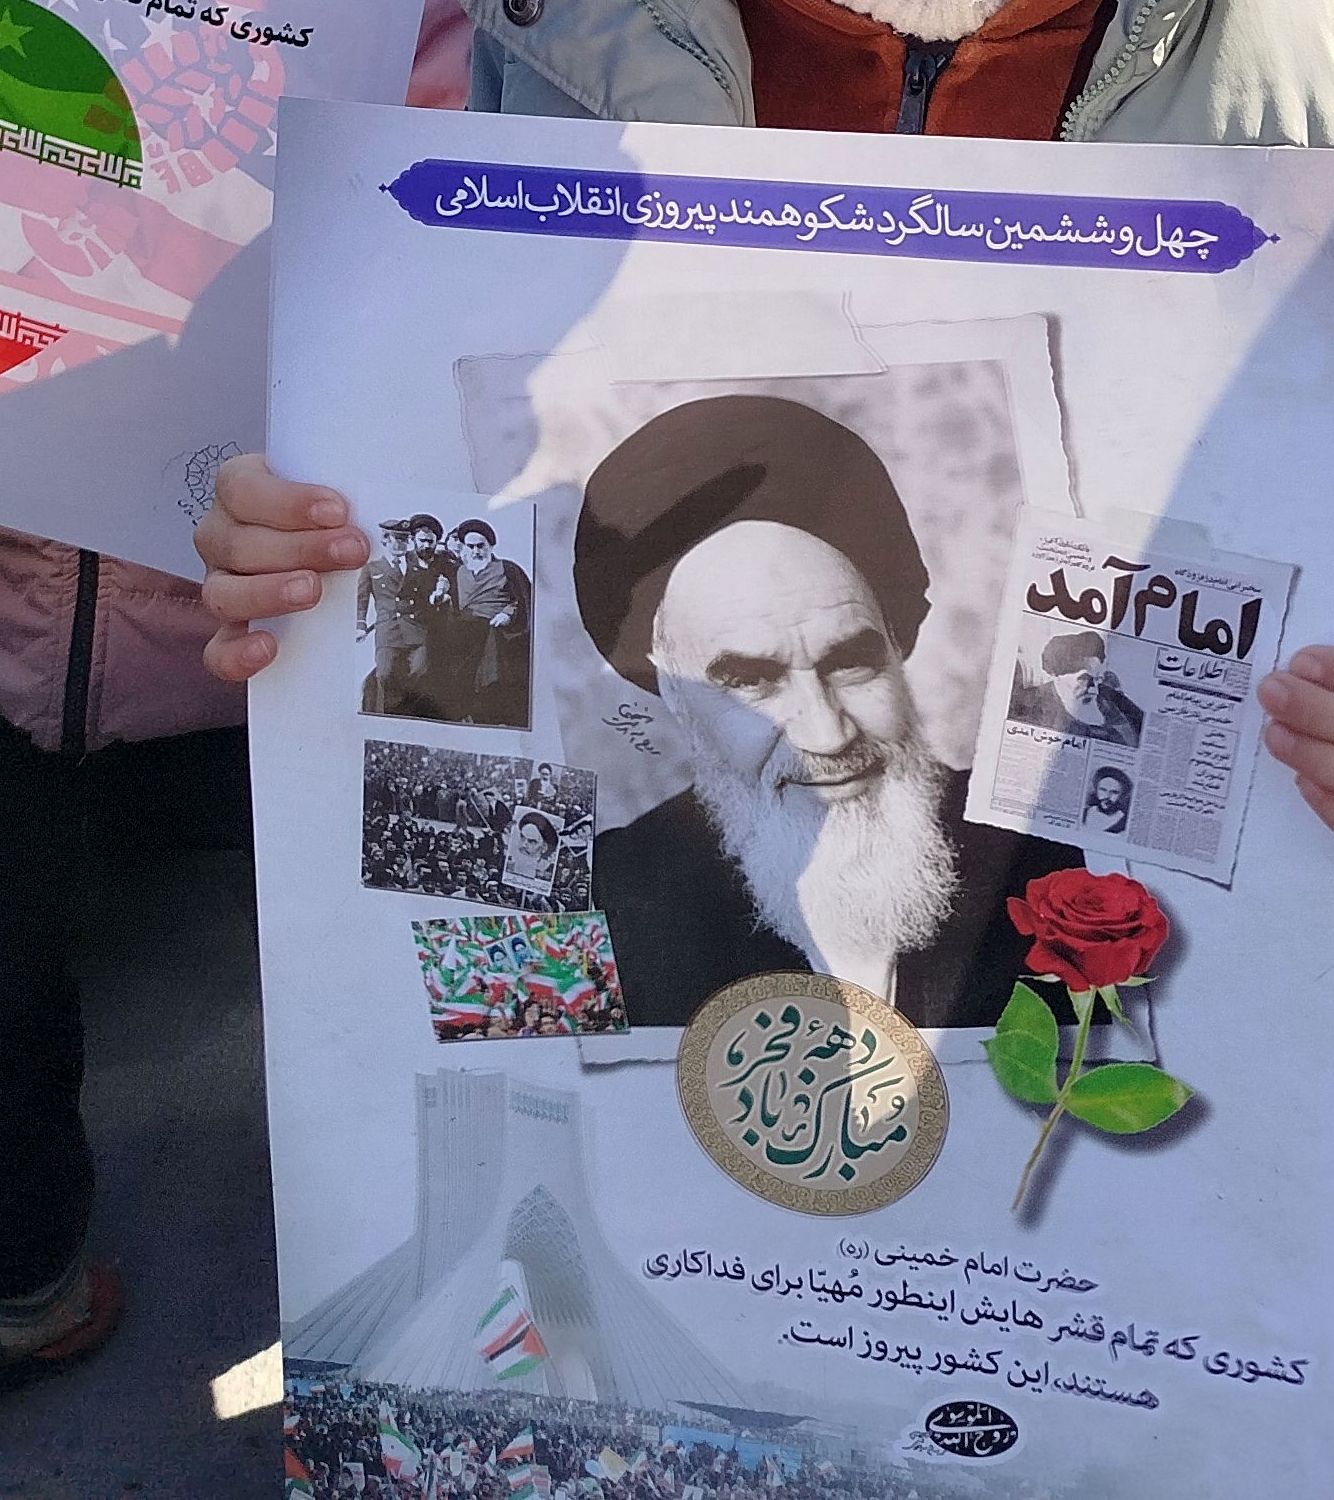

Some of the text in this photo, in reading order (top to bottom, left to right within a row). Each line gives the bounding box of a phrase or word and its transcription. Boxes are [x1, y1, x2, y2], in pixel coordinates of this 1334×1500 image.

[200, 5, 230, 26] که
[230, 20, 315, 48] کشوری
[435, 174, 524, 217] اسلامی
[525, 181, 621, 222] انقلاب
[622, 189, 717, 235] پیروزی
[718, 193, 874, 242] شکوهمند
[877, 193, 984, 246] سالگرد
[985, 213, 1116, 251] ششمین
[1135, 212, 1219, 260] چهل
[1026, 555, 1265, 660] امام آمد
[645, 1248, 746, 1281] فداکاری
[874, 1244, 959, 1271] خمینی
[963, 1251, 1009, 1285] امام
[751, 1264, 804, 1299] برای
[1013, 1260, 1099, 1293] حضرت
[868, 1279, 955, 1321] اینطور
[856, 1329, 923, 1375] پیروز
[1109, 1323, 1160, 1363] تمام
[1163, 1334, 1201, 1360] که
[926, 1349, 1004, 1375] کشور
[1006, 1360, 1049, 1394] این
[1203, 1351, 1310, 1386] کشوری
